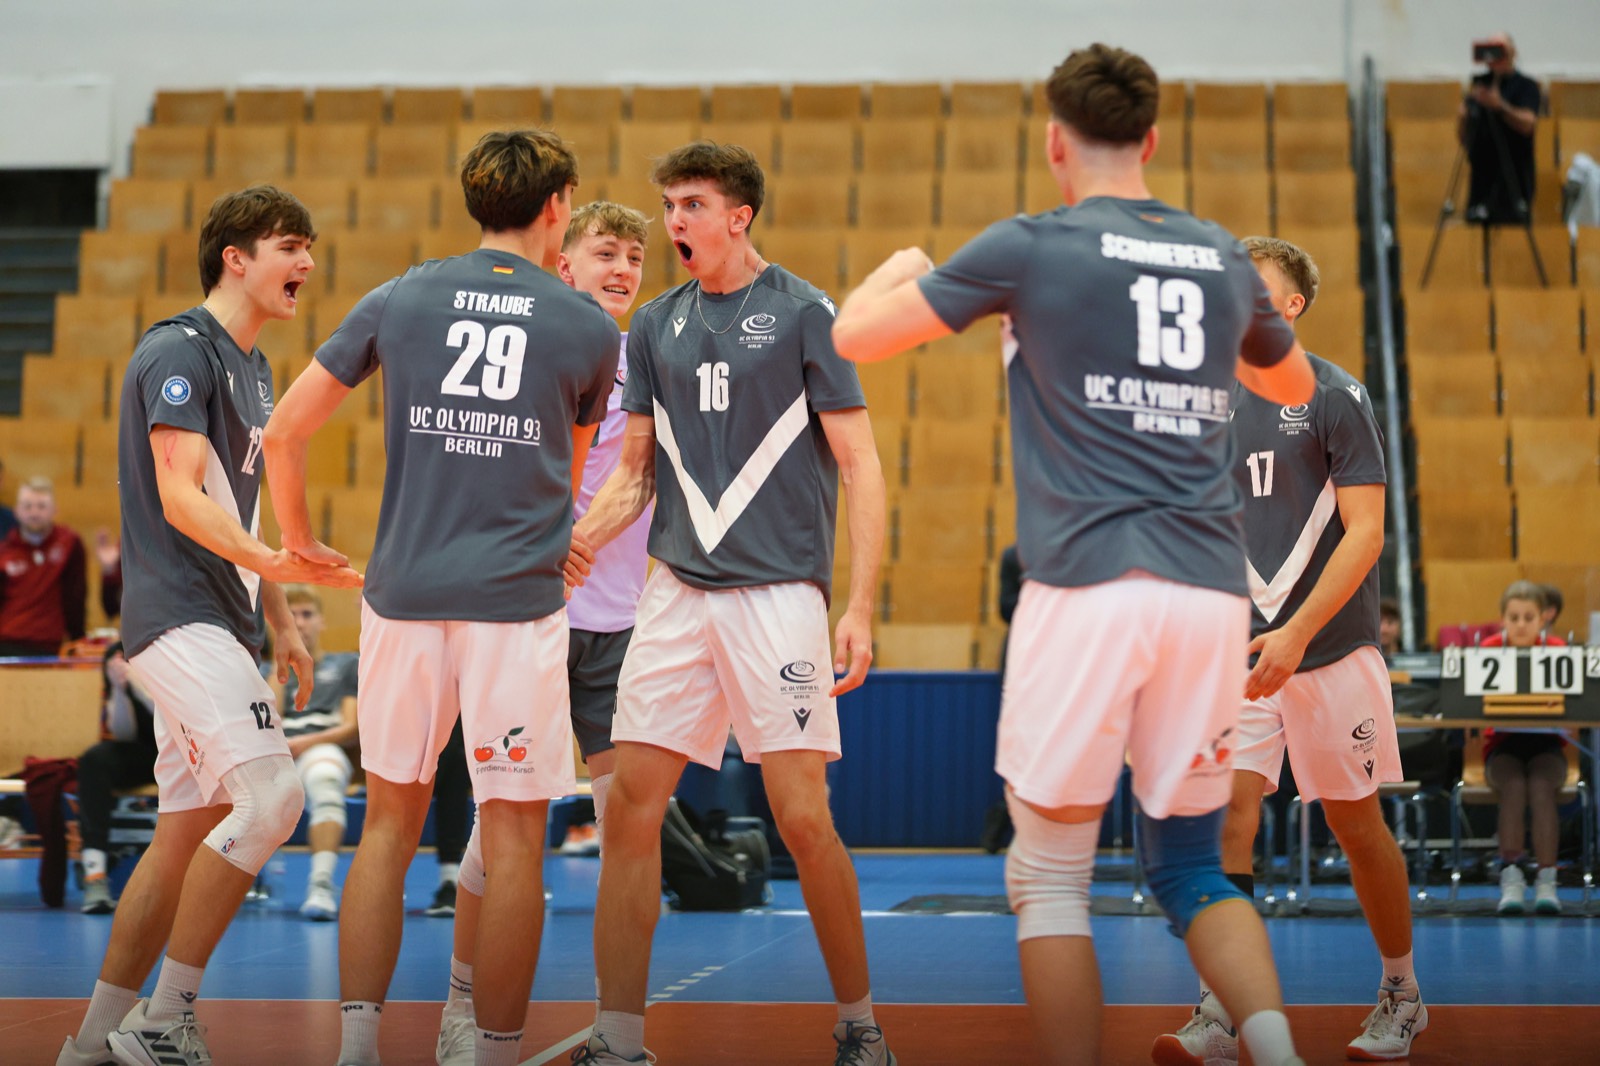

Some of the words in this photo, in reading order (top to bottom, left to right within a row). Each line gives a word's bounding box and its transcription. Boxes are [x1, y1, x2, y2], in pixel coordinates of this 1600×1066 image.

[453, 291, 535, 317] STRAUBE
[1129, 274, 1205, 371] 13
[441, 320, 527, 401] 29
[696, 361, 730, 412] 16
[1118, 377, 1211, 412] OLYMPIA
[436, 408, 519, 437] OLYMPIA
[523, 418, 541, 441] 93
[241, 425, 263, 476] 12
[445, 438, 503, 458] BERLIN
[1246, 450, 1275, 498] 17
[1482, 657, 1500, 690] 2
[1538, 655, 1574, 689] 10
[249, 701, 275, 730] 12
